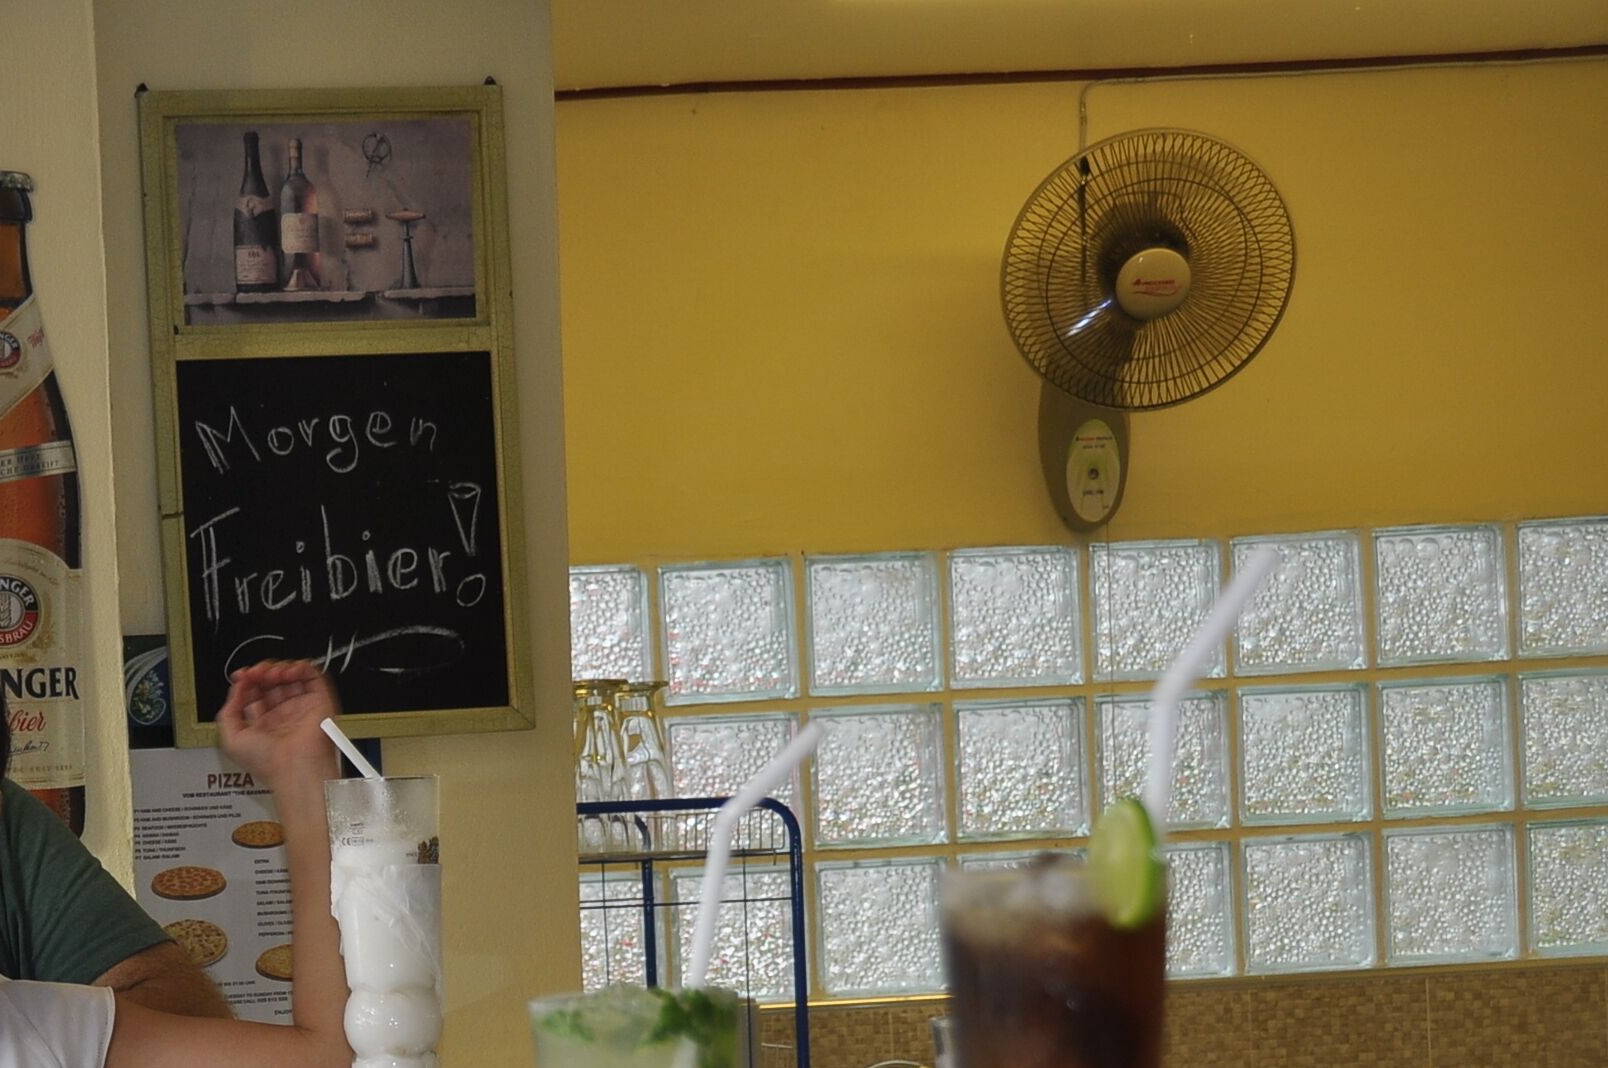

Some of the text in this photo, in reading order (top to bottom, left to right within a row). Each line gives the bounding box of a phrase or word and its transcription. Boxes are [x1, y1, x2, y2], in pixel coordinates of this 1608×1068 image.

[194, 405, 438, 474] Morgen
[0, 667, 79, 700] NGER
[8, 709, 46, 732] bier
[207, 772, 255, 789] PIZZA
